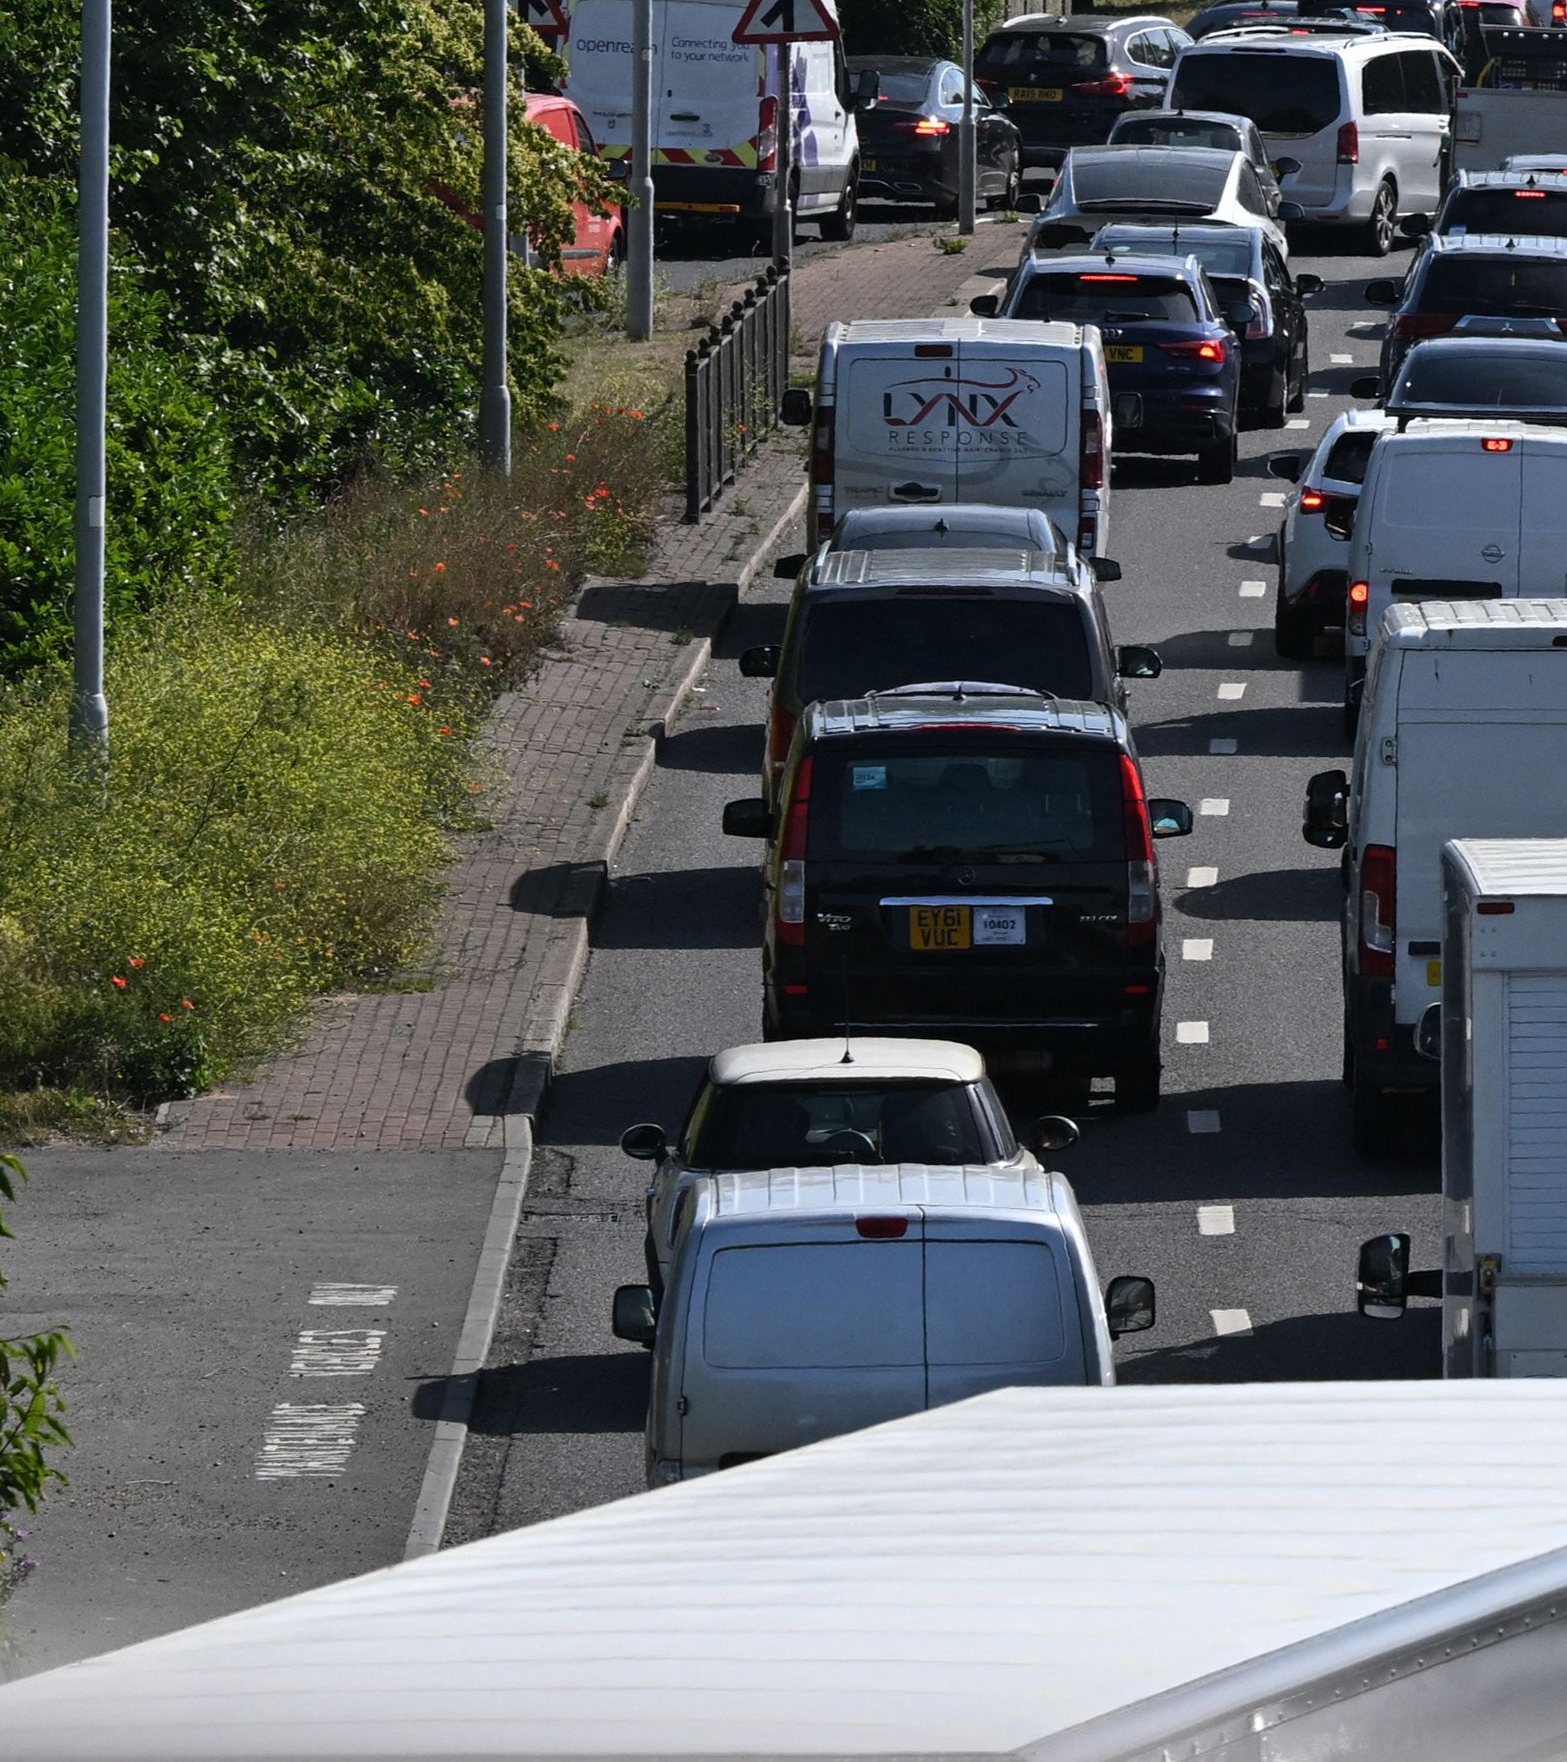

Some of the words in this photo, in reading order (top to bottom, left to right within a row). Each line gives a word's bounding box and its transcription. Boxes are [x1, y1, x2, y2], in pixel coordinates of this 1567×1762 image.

[672, 37, 728, 50] Connecting
[672, 50, 682, 60] to
[684, 52, 706, 62] your
[708, 53, 750, 62] network
[1109, 348, 1133, 360] VNC
[883, 392, 1021, 427] LYNX
[889, 431, 1027, 445] RESPONSE
[918, 909, 961, 928] EY61
[921, 929, 958, 947] VUC
